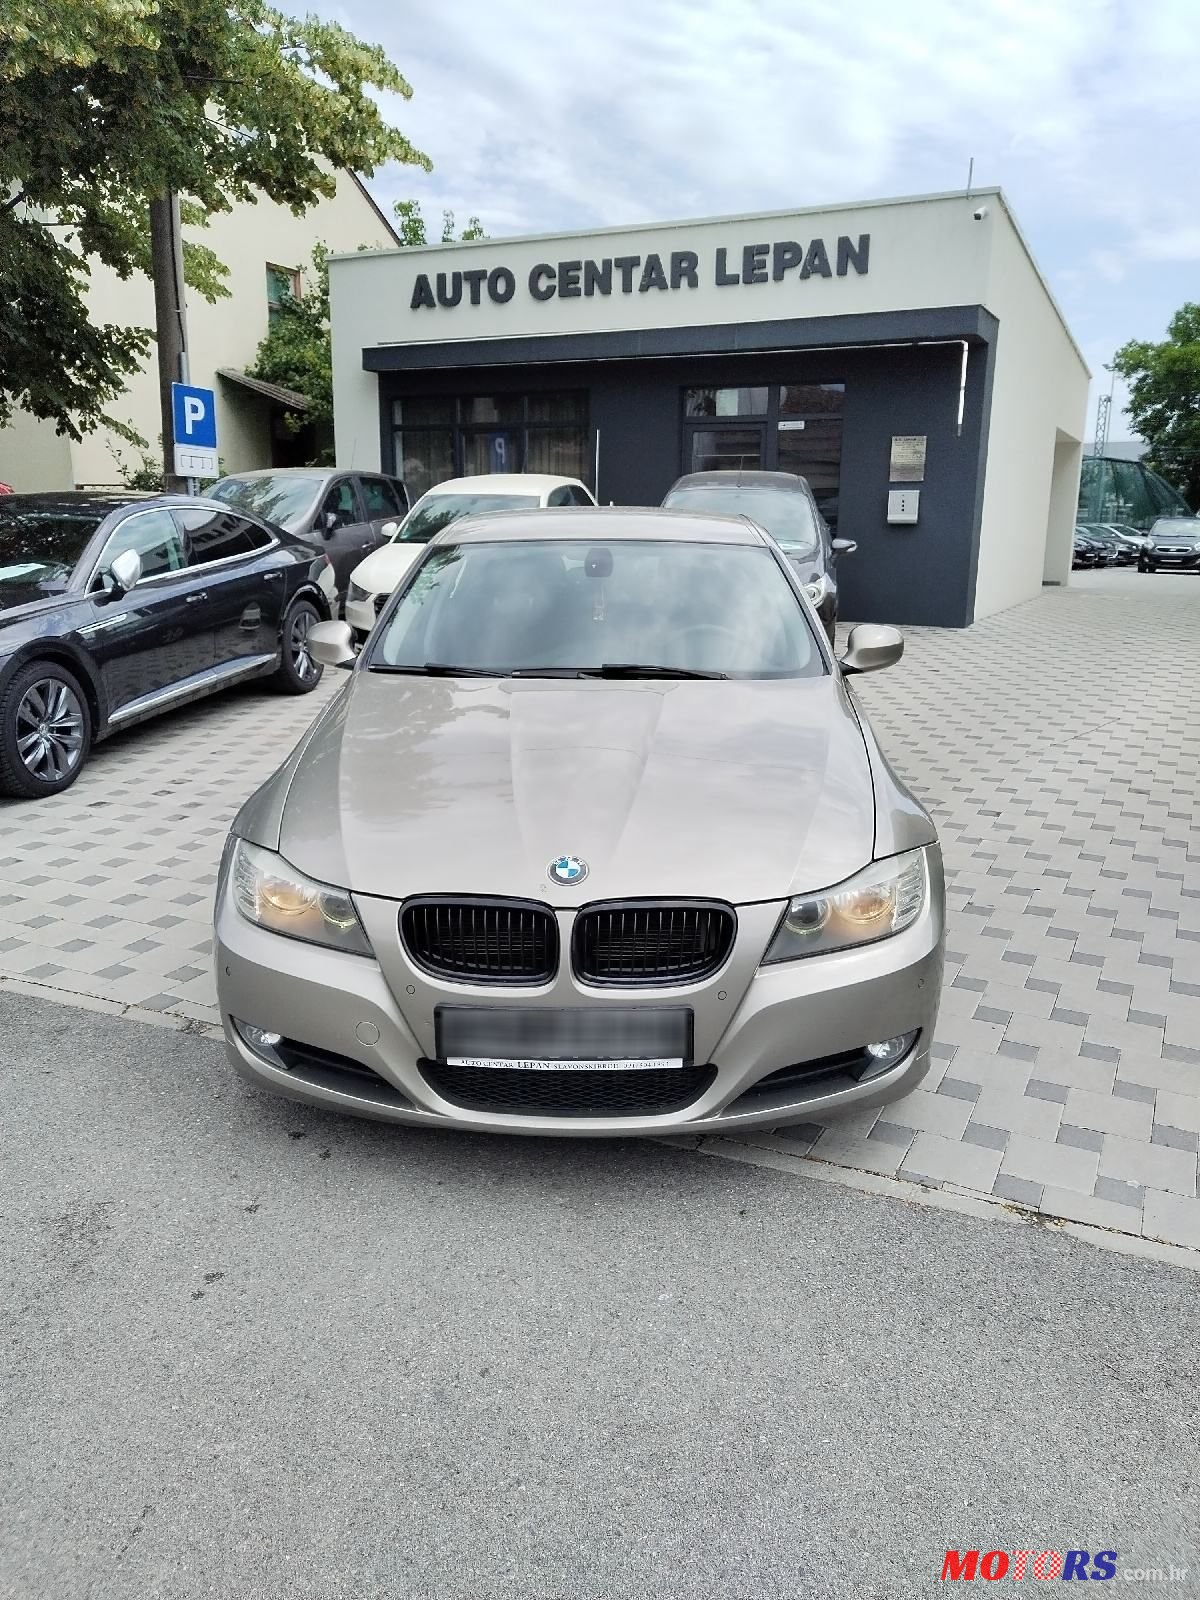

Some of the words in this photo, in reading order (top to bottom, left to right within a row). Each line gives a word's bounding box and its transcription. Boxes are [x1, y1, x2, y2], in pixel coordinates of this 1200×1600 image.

[410, 268, 516, 309] AUTO
[528, 251, 699, 300] CENTAR
[715, 234, 871, 285] LEPAN
[184, 396, 205, 435] P
